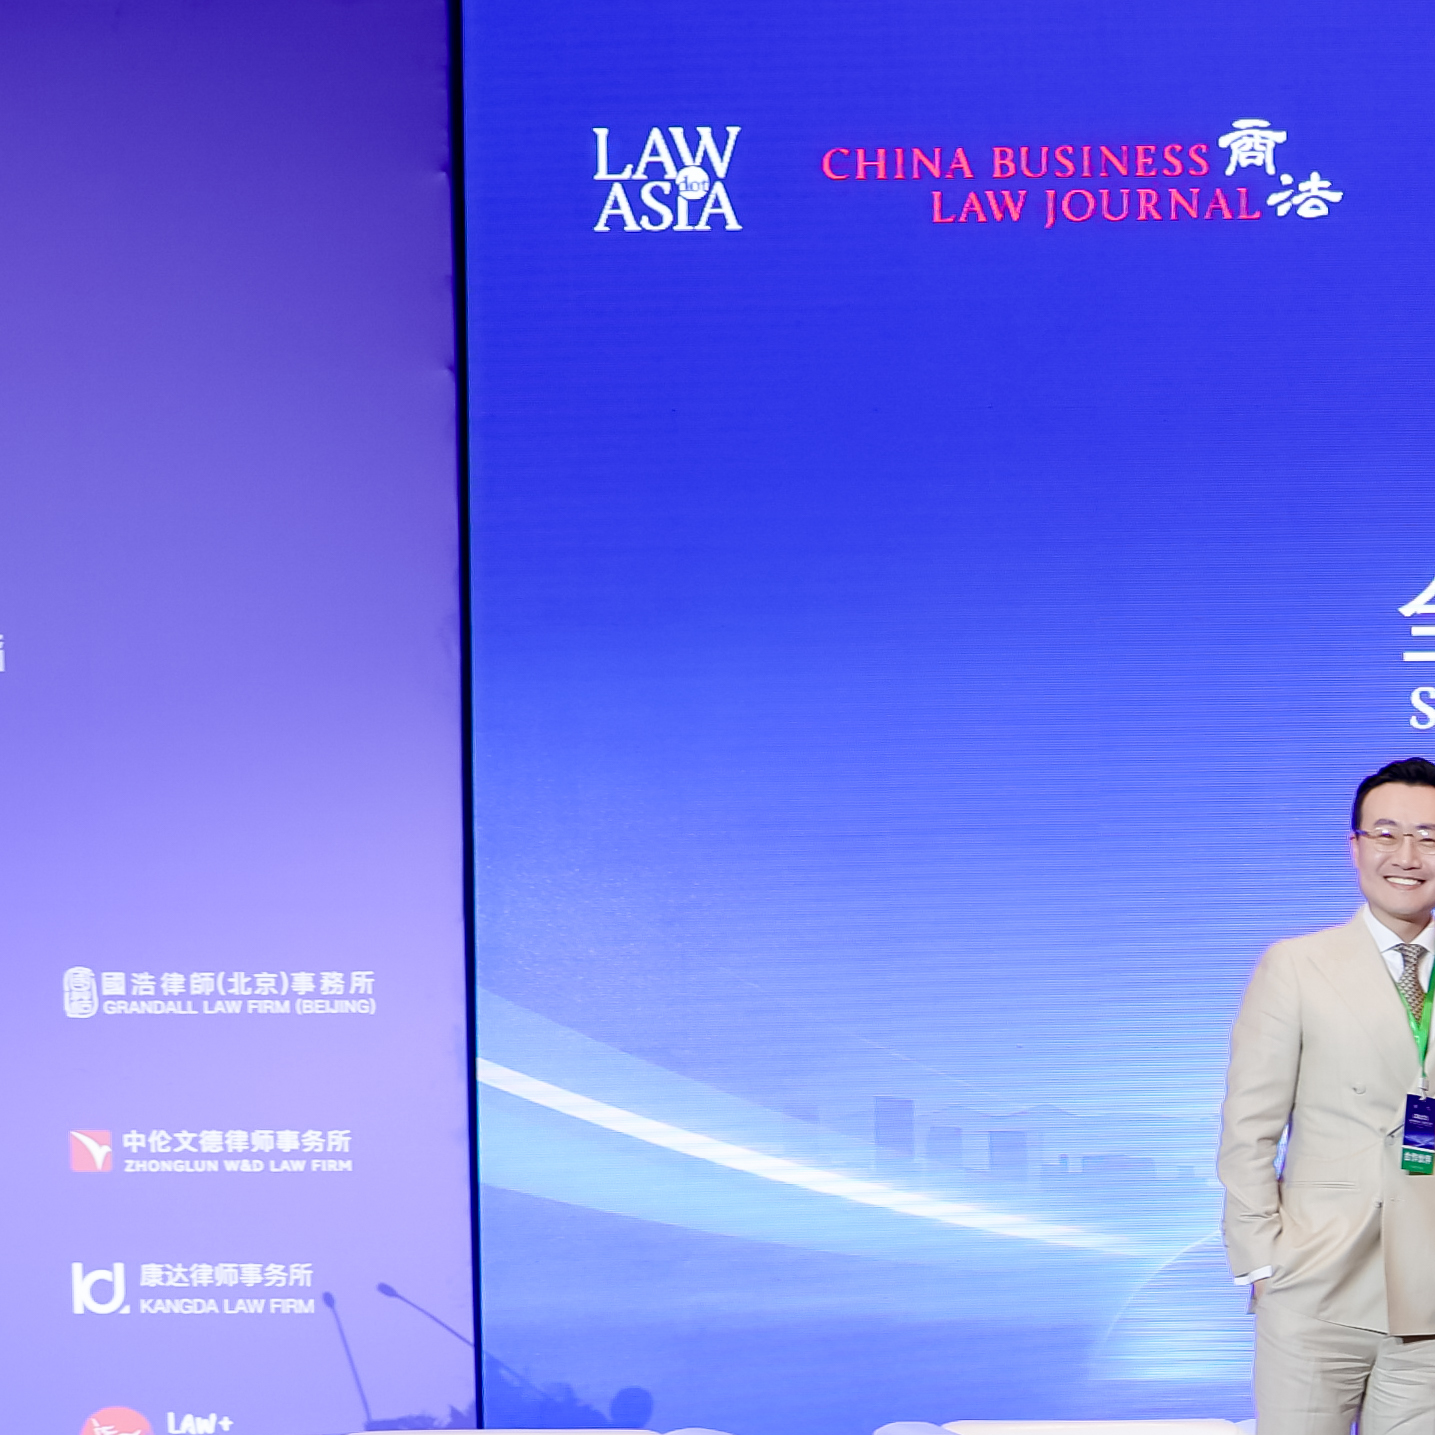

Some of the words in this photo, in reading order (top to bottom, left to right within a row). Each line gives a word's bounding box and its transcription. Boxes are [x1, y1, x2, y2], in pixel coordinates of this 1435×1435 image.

[592, 126, 742, 180] LAW
[822, 146, 973, 180] CHINA
[992, 143, 1211, 179] BUSINESS
[593, 181, 743, 232] ASIA
[932, 190, 1027, 224] LAW
[1044, 187, 1261, 229] JOURNAL
[103, 999, 198, 1014] GRANDALL
[203, 999, 242, 1014] LAW
[248, 999, 290, 1014] FIRM
[295, 998, 376, 1015] (BEIJING)
[122, 1129, 351, 1153] 中伦文德律师事务所
[124, 1160, 219, 1172] ZHONGLUN
[224, 1160, 264, 1172] W&D
[270, 1160, 305, 1172] LAW
[311, 1160, 353, 1172] FIRM
[140, 1263, 313, 1288] 康达律师事务所
[140, 1299, 219, 1314] KANGDA
[224, 1299, 264, 1314] LAW
[270, 1299, 315, 1314] FIRM
